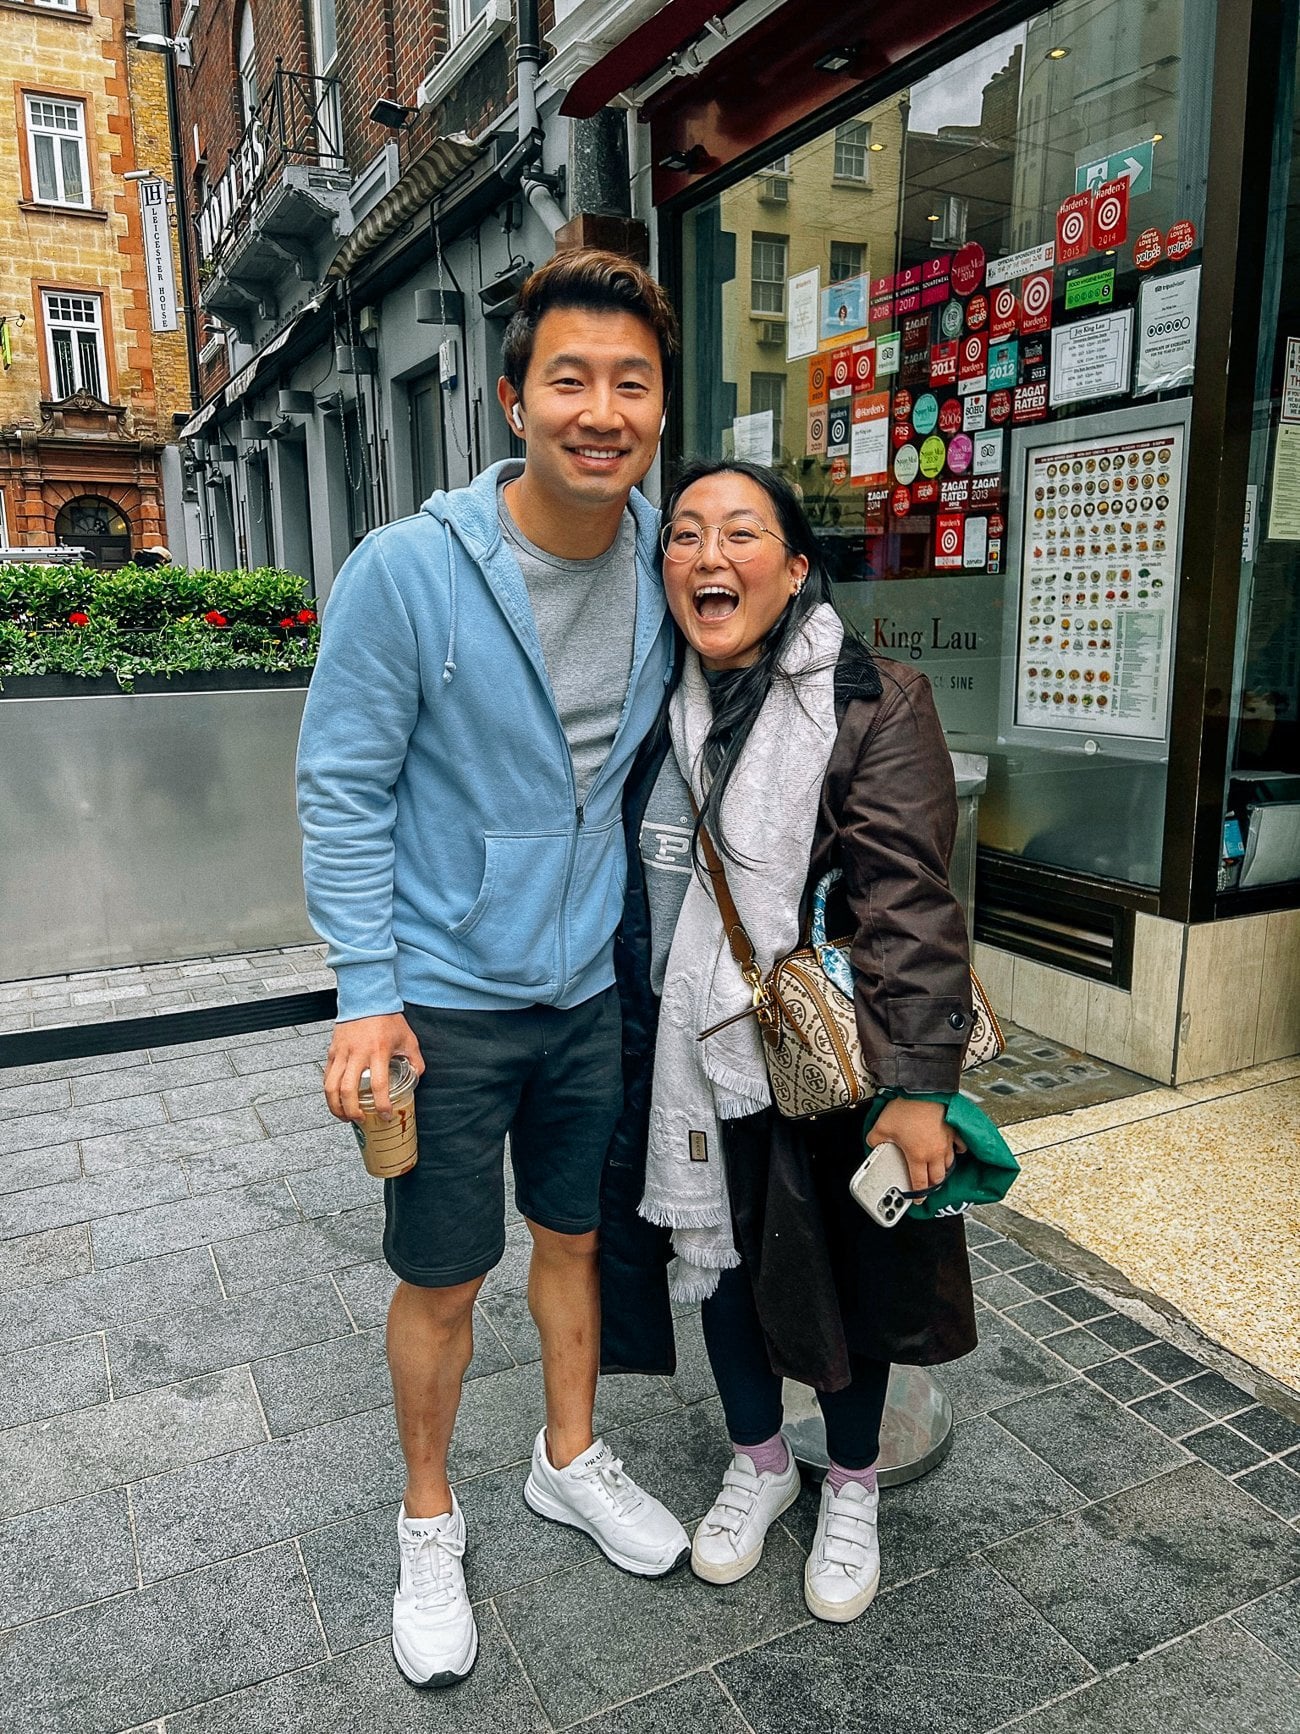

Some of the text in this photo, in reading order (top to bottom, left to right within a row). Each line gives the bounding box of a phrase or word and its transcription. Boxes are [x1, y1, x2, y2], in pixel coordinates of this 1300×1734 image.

[1096, 182, 1126, 198] Harden's
[1060, 196, 1088, 214] Harden's
[1098, 232, 1116, 246] 2014
[1170, 230, 1184, 238] LOVE
[1138, 238, 1152, 246] LOVE
[1062, 246, 1080, 260] 2015
[1168, 242, 1185, 256] yelp
[1136, 250, 1154, 264] yelp
[152, 207, 169, 328] LEICESTER HOUSE
[960, 270, 975, 282] 2014
[1068, 280, 1080, 288] FOOD
[1104, 286, 1109, 296] 5
[899, 296, 916, 312] 2017
[873, 305, 890, 318] 2018
[905, 316, 928, 330] ZAGAT
[992, 319, 1016, 331] Harden's
[1023, 316, 1048, 328] Harden's
[1084, 326, 1094, 334] King
[904, 351, 928, 364] ZAGAT
[932, 360, 956, 377] 2011
[962, 362, 984, 374] Harden's
[990, 364, 1014, 380] 2012
[1031, 369, 1046, 379] 2013
[1014, 384, 1046, 399] ZAGAT
[970, 398, 974, 406] I
[1014, 396, 1046, 410] RATED
[966, 404, 984, 416] SOHO
[940, 414, 962, 426] 2006
[895, 426, 909, 436] PRS
[942, 480, 968, 492] ZAGAT
[972, 478, 1000, 490] ZAGAT
[867, 490, 889, 500] ZAGAT
[941, 490, 968, 502] RATED
[972, 490, 988, 500] 2013
[940, 520, 960, 528] Harden's
[874, 618, 978, 660] King Lau
[584, 1449, 605, 1466] PRAD
[412, 1528, 441, 1538] PRAA
